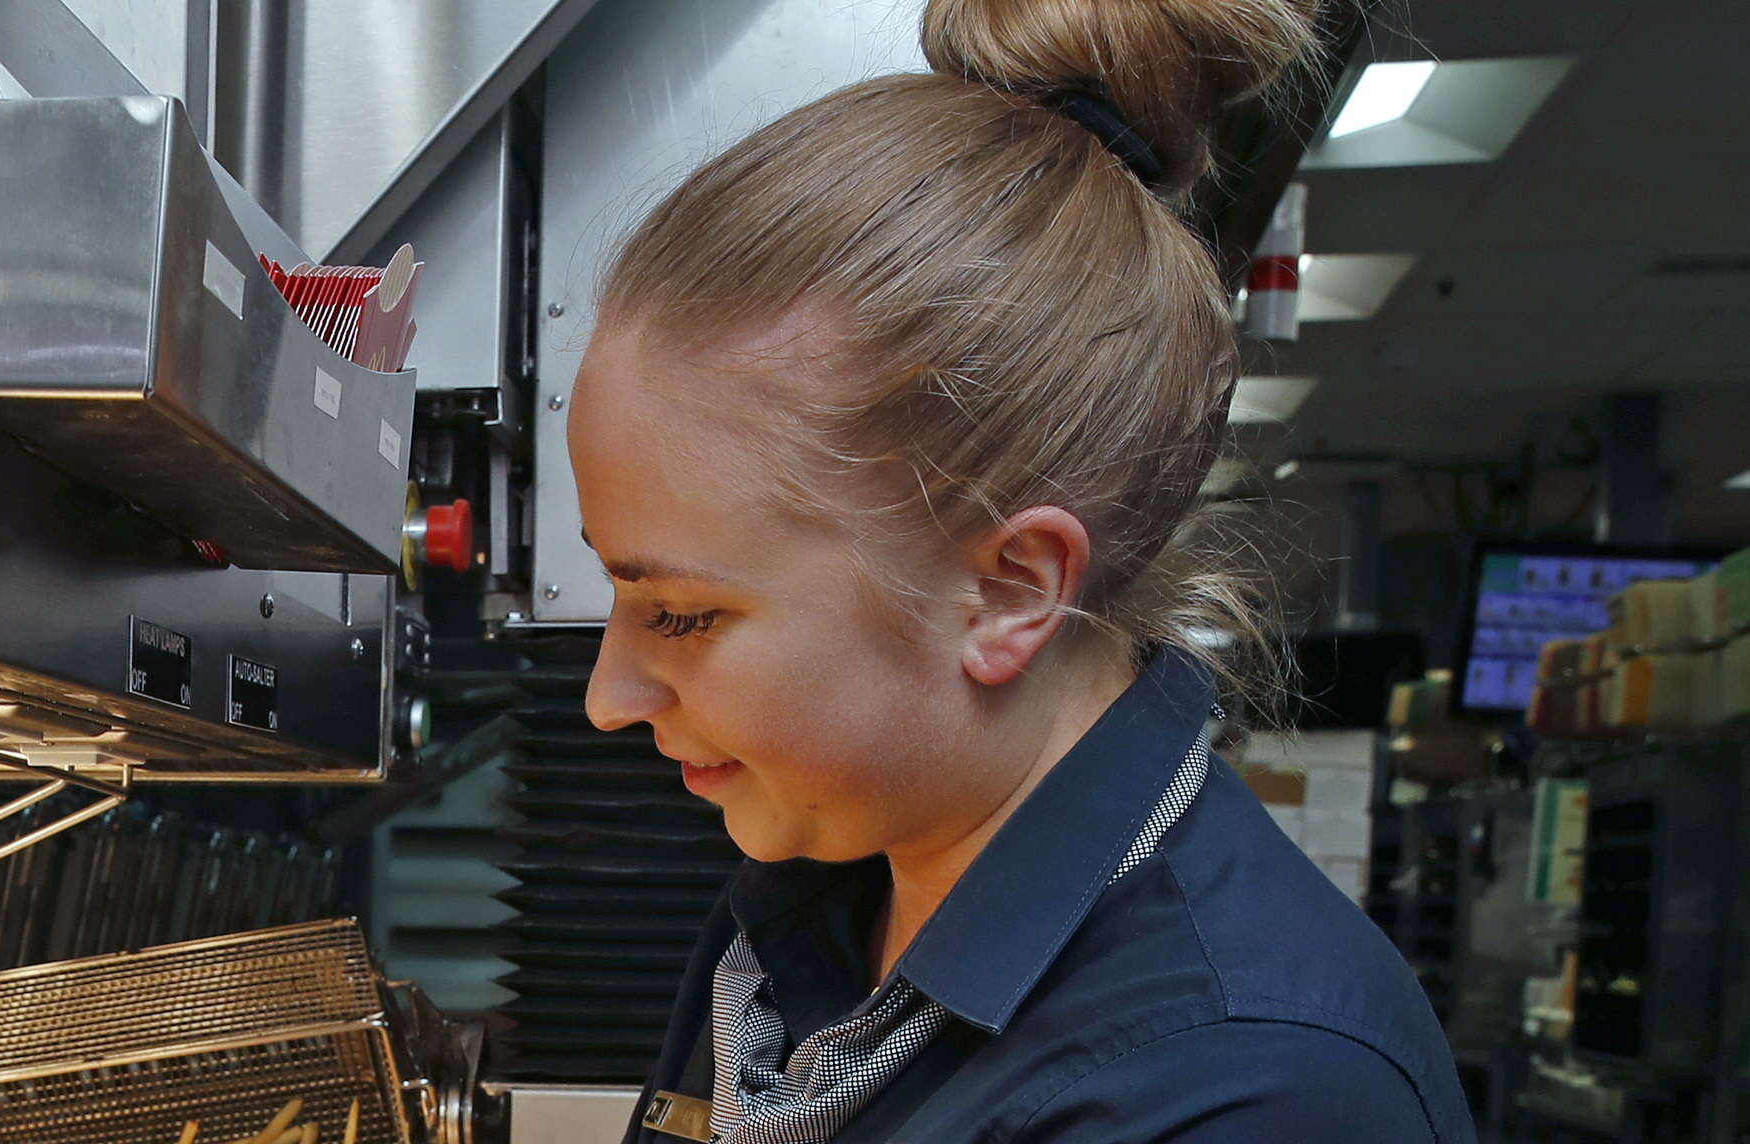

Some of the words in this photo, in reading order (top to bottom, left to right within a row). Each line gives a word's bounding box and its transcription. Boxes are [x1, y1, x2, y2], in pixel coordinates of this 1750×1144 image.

[139, 622, 160, 649] HEAT
[161, 630, 186, 657] LAMPS
[132, 668, 147, 692] OFF
[234, 659, 275, 688] AUTO-SALTER
[180, 683, 191, 706] ON
[268, 710, 278, 729] ON
